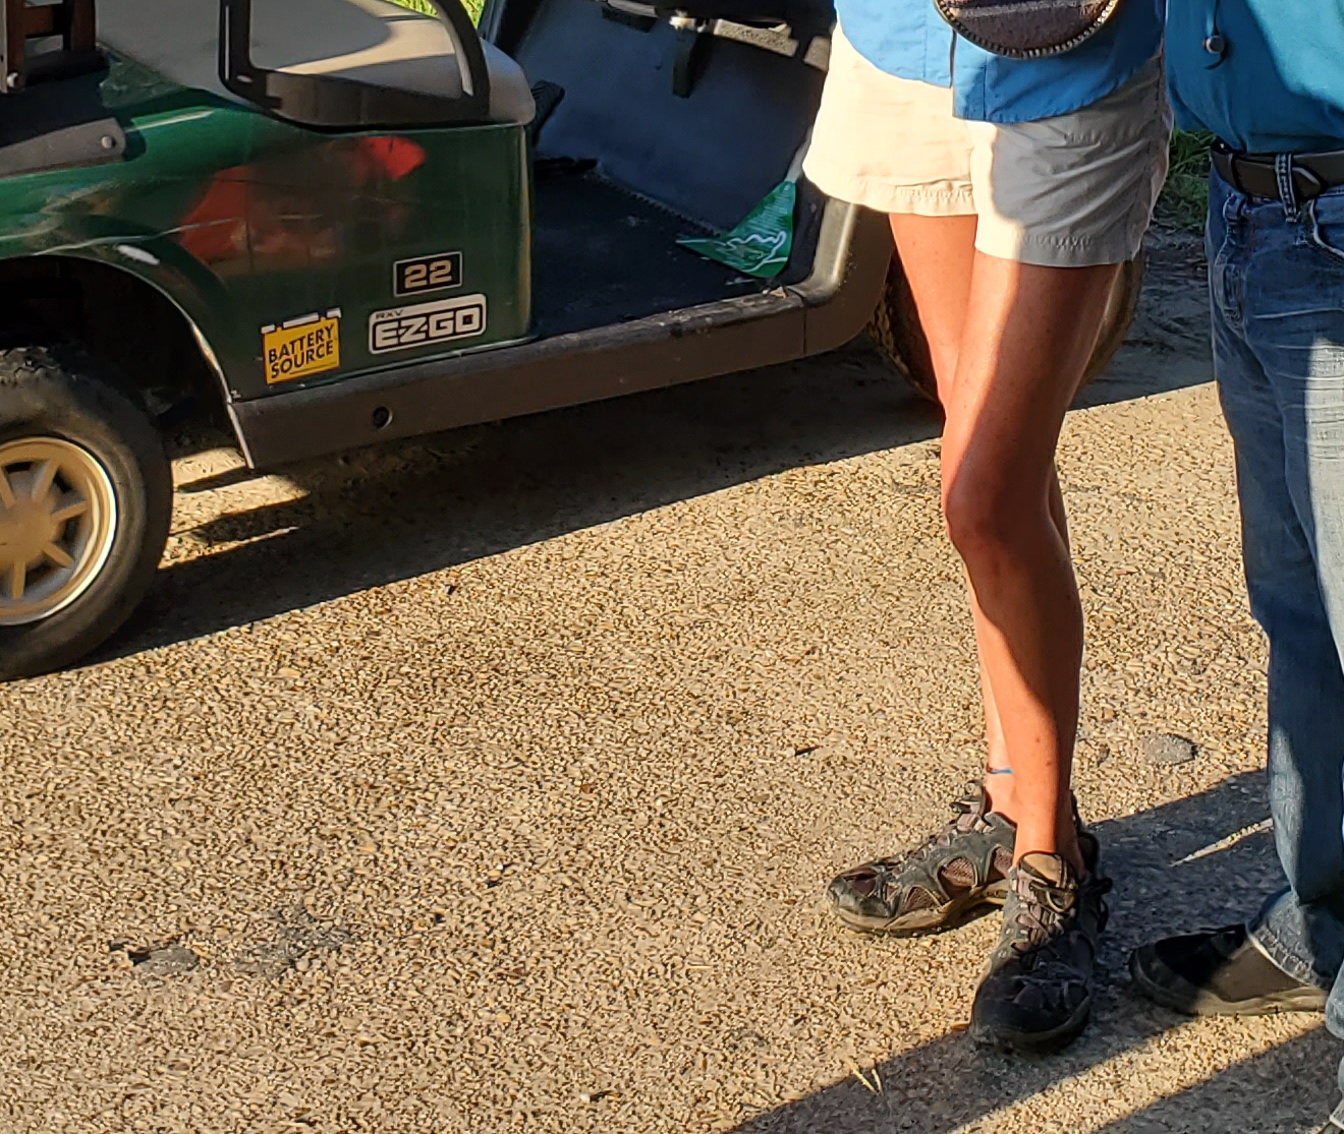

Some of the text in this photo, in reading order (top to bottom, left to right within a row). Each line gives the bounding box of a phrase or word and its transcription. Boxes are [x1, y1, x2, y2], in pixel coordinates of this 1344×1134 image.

[404, 260, 452, 289] 22
[268, 323, 335, 364] BATTERY
[271, 339, 334, 379] SOURCE
